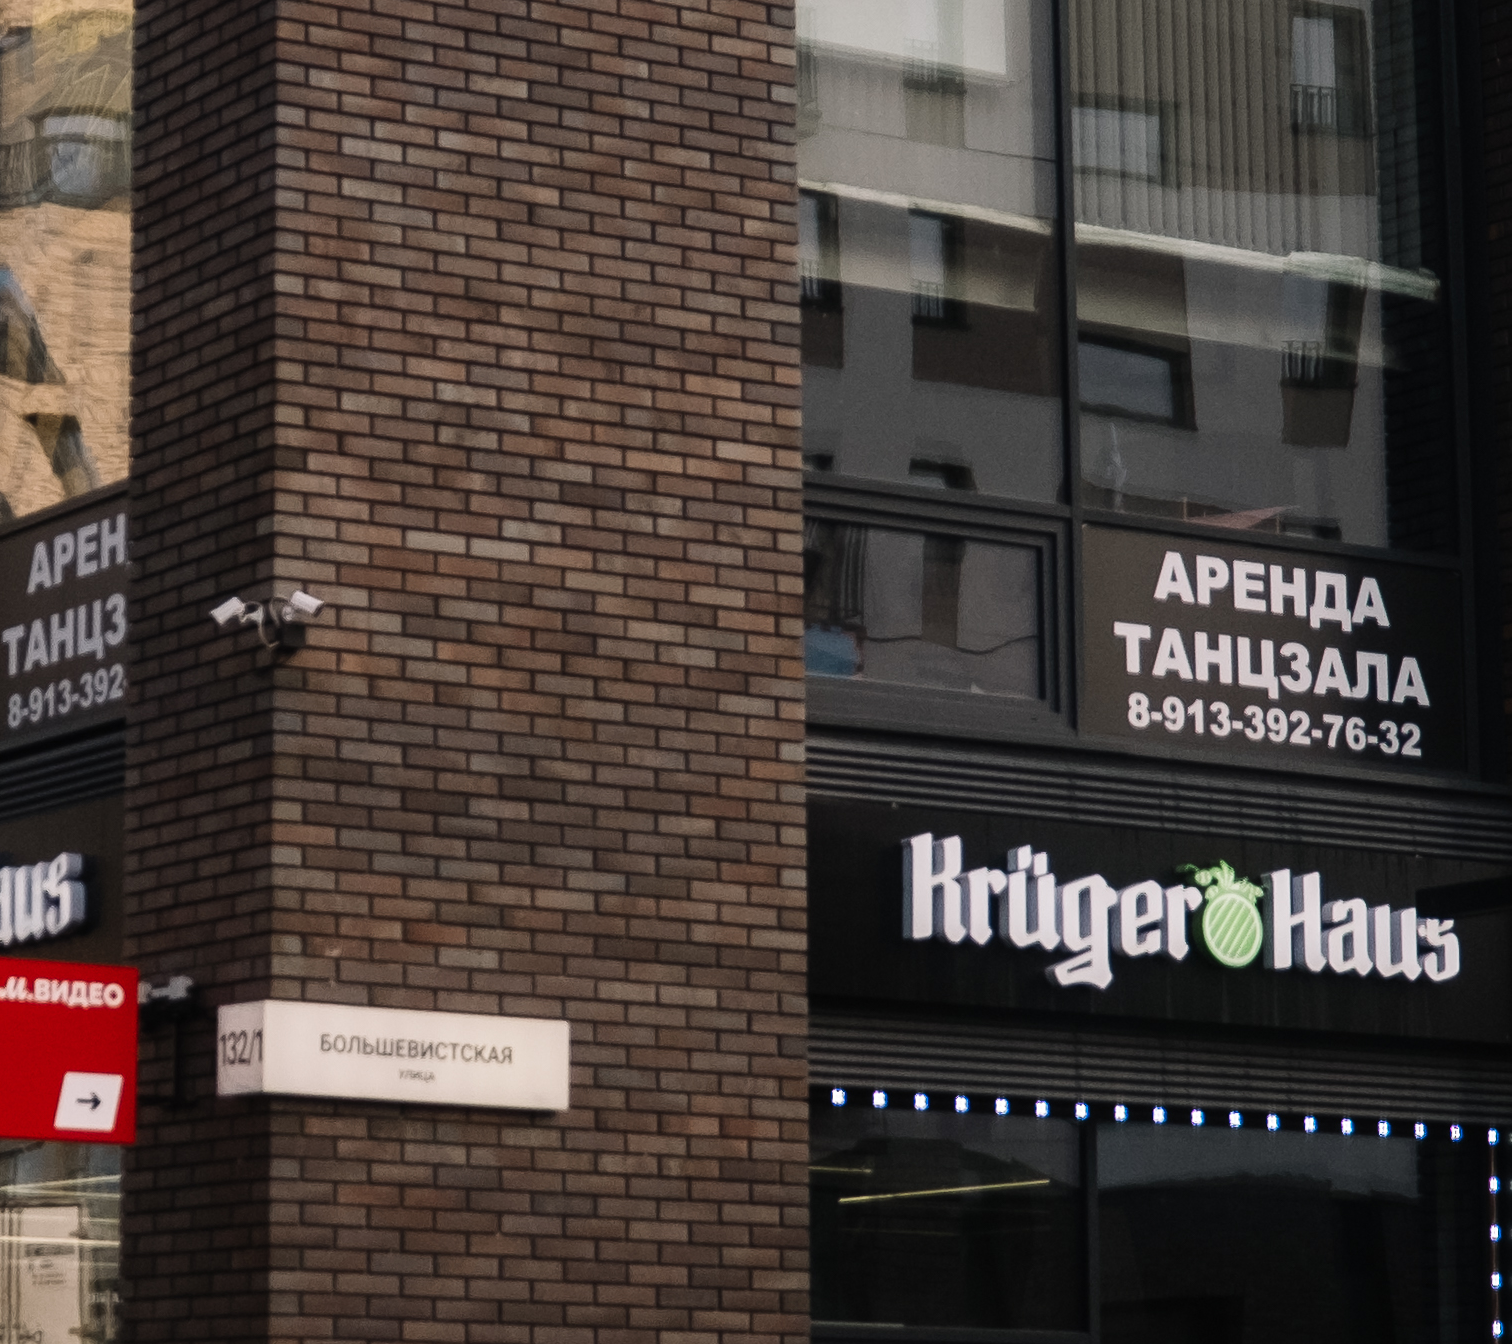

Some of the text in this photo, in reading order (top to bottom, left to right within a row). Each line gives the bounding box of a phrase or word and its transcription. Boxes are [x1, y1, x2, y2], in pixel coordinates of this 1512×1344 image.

[1153, 550, 1391, 633] АРЕНДА
[1113, 620, 1431, 708] ТАНЦЗАЛА
[1127, 692, 1423, 758] 8-913-392-76-32
[901, 831, 1462, 990] Krüger Haus
[319, 1032, 515, 1065] БОЛЬШЕВИСТСКАЯ
